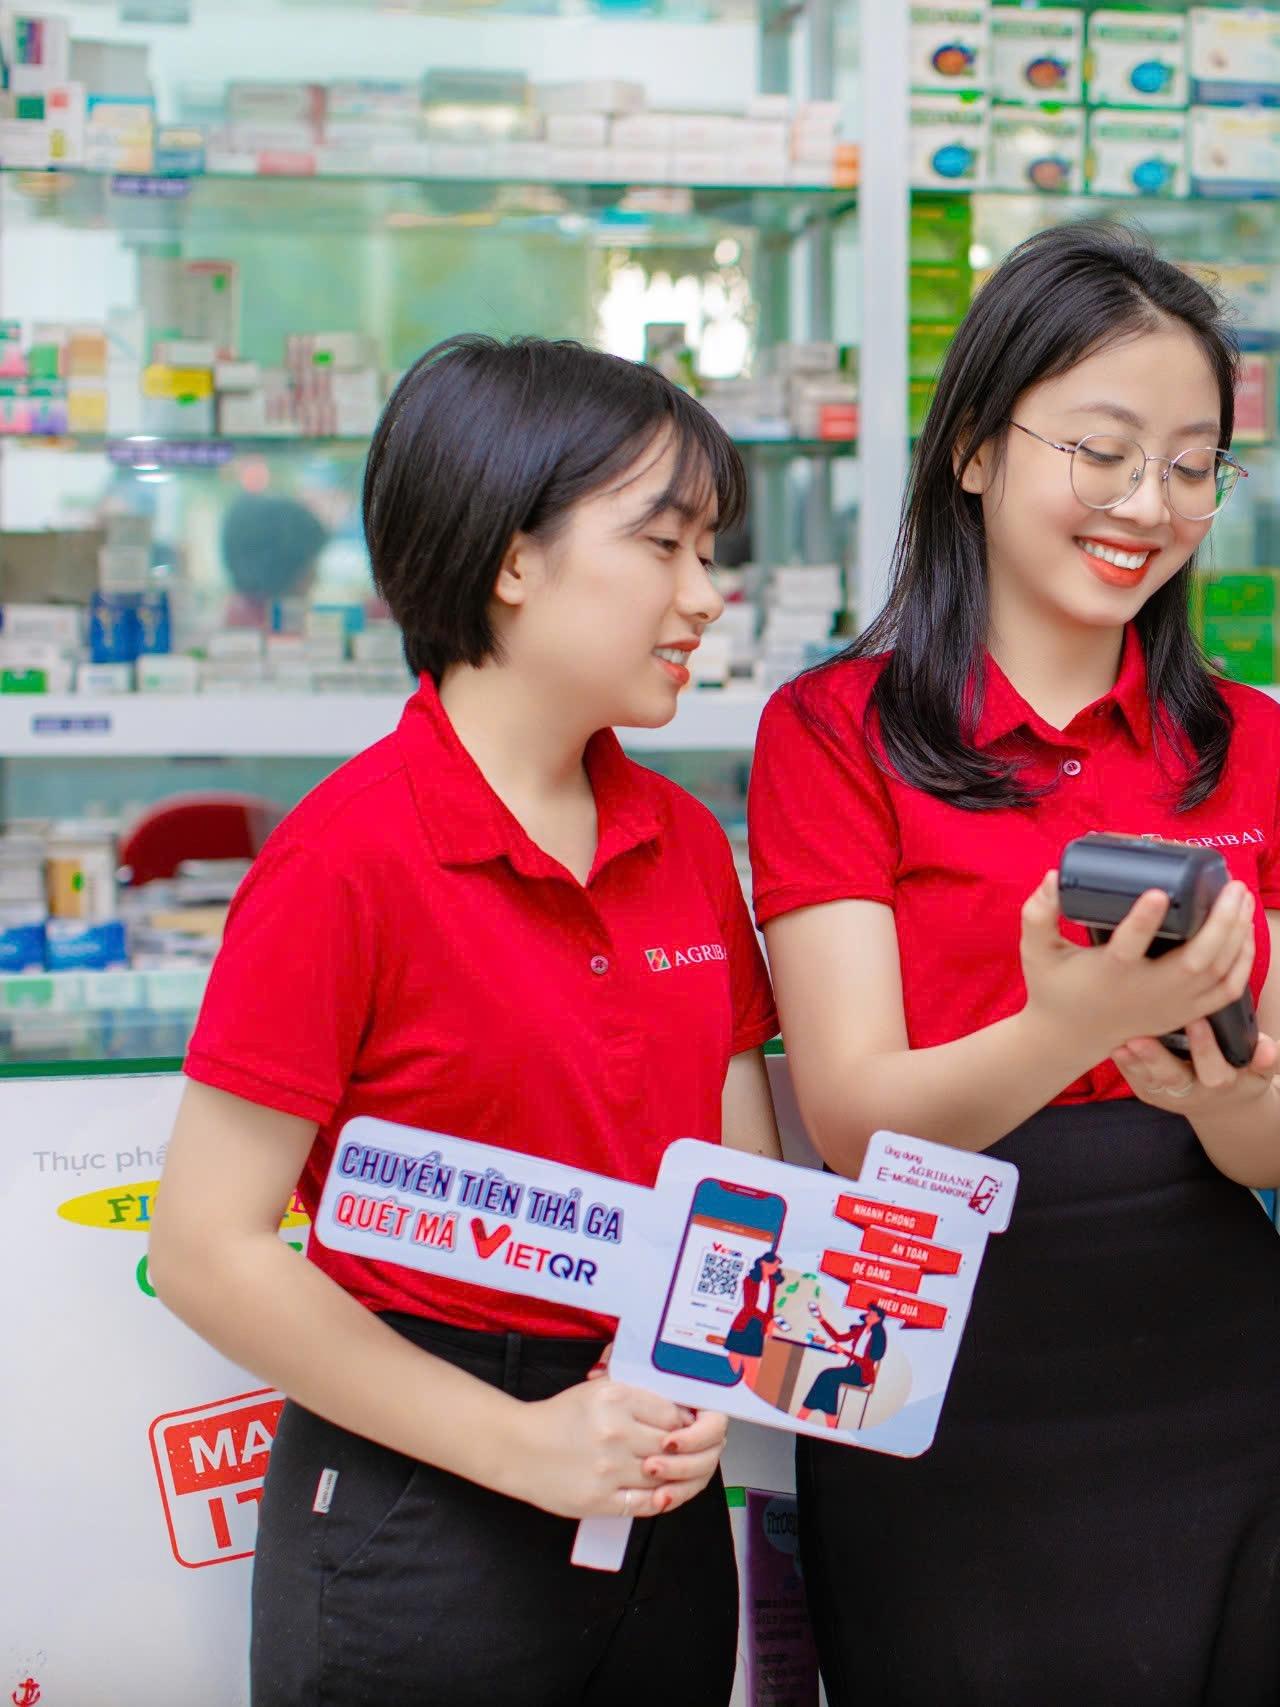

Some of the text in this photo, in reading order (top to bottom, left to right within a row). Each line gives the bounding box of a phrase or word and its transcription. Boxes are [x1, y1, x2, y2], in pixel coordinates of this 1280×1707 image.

[33, 1150, 106, 1177] Thực
[908, 1166, 976, 1189] AGRIBANK
[527, 1188, 582, 1233] THẢ
[584, 1203, 625, 1244] GA
[853, 1203, 884, 1220] NHANH
[335, 1191, 599, 1286] QUÉT MÃ VIETQR
[891, 1242, 905, 1257] AN
[189, 1420, 274, 1475] MA
